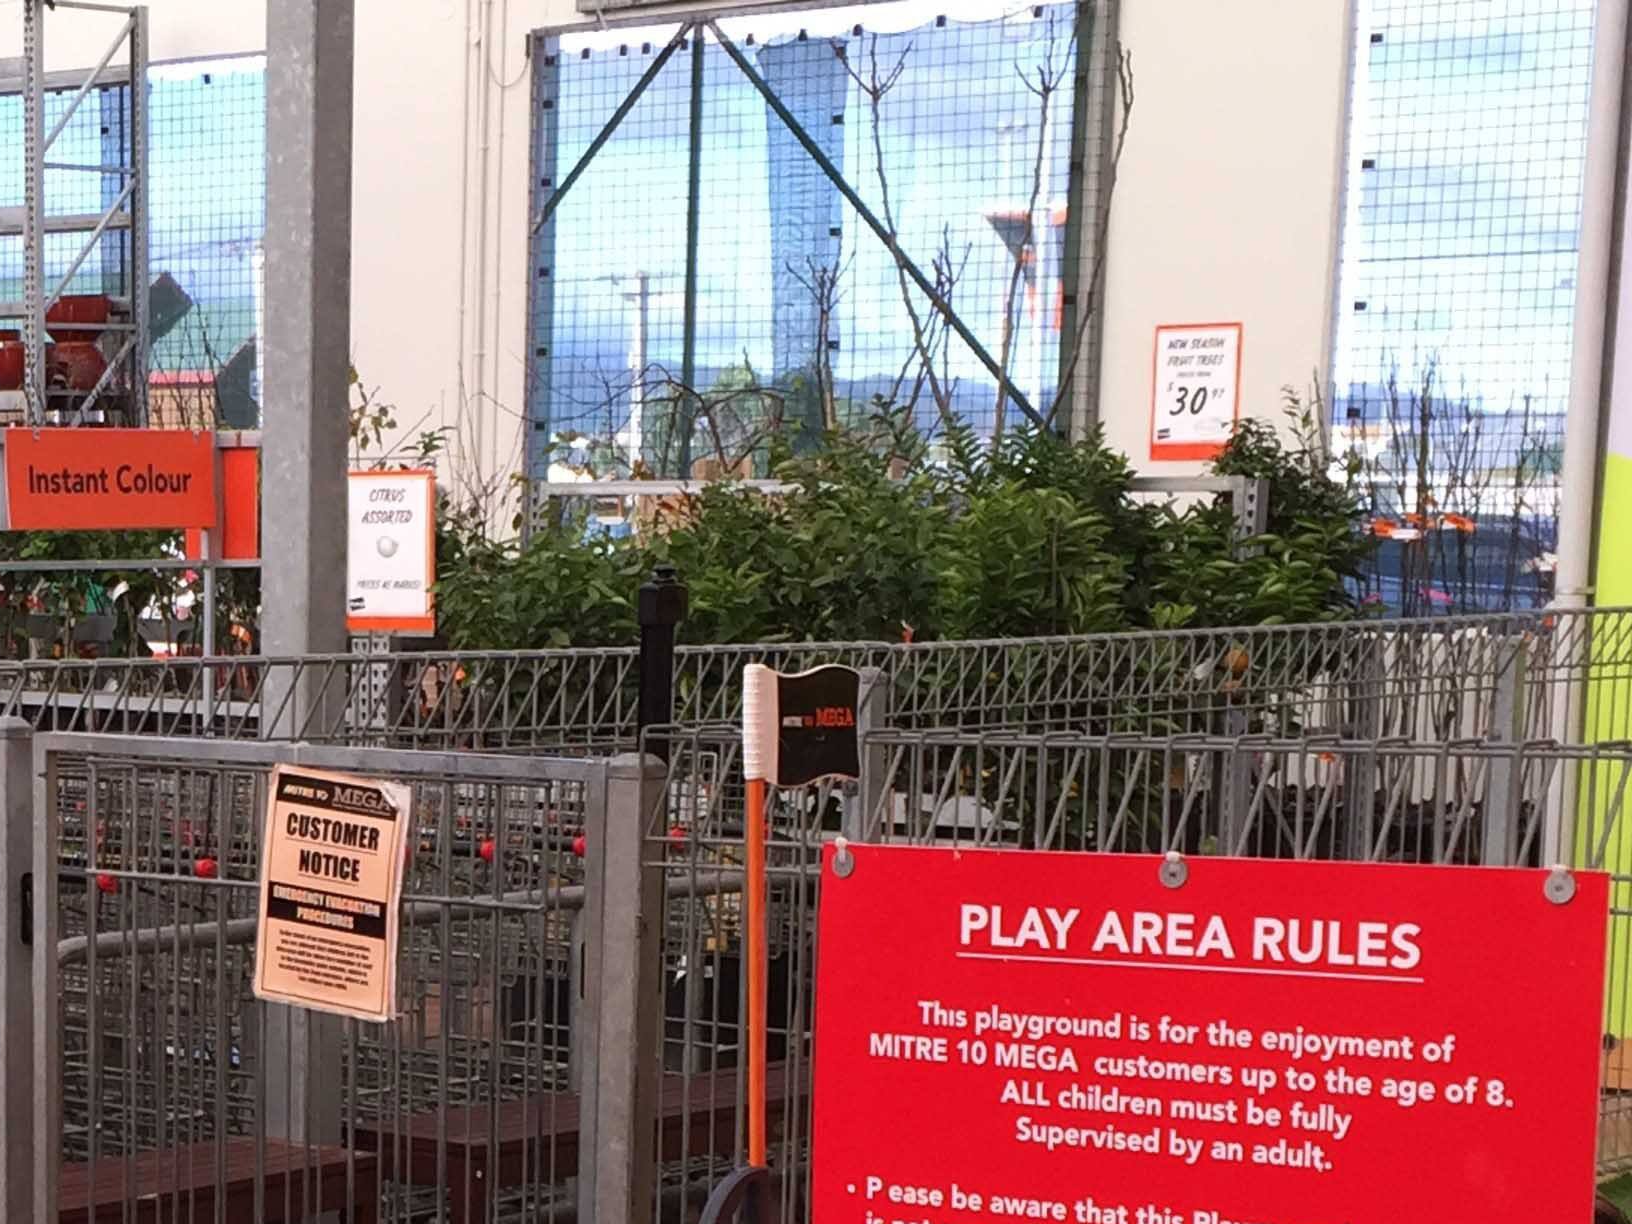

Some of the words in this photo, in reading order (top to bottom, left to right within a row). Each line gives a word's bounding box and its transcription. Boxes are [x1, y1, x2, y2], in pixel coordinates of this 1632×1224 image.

[1168, 339, 1189, 349] NEW
[1191, 337, 1225, 349] SEASON
[1168, 355, 1194, 366] FRUIT
[1196, 354, 1224, 366] TREES
[1169, 386, 1208, 416] 30
[29, 465, 109, 494] Instant
[117, 464, 191, 494] Colour
[369, 488, 406, 503] CITRUS
[361, 510, 413, 524] ASSORTED
[287, 812, 380, 850] CUSTOMER
[299, 849, 361, 882] NOTICE
[961, 904, 1079, 950] PLAY
[1092, 911, 1234, 960] AREA
[1253, 918, 1421, 970] RULES
[918, 1001, 967, 1028] This
[976, 1004, 1120, 1041] playground
[1129, 1015, 1151, 1041] is
[1158, 1016, 1200, 1044] for
[1206, 1020, 1253, 1048] the
[1262, 1027, 1413, 1063] enjoyment
[1423, 1034, 1456, 1063] of
[870, 1033, 947, 1062] MITRE
[958, 1040, 986, 1065] 10
[996, 1043, 1079, 1073] MEGA
[1094, 1056, 1232, 1086] customers
[1241, 1068, 1276, 1095] up
[1285, 1066, 1315, 1092] to
[1324, 1067, 1372, 1096] the
[1381, 1079, 1436, 1107] age
[1444, 1077, 1479, 1104] of
[1486, 1079, 1514, 1107] 8.
[1001, 1080, 1050, 1107] ALL
[1059, 1084, 1162, 1117] children
[1171, 1099, 1237, 1124] must
[1247, 1097, 1282, 1127] be
[1290, 1102, 1352, 1140] fully
[1016, 1117, 1161, 1154] Supervised
[1169, 1130, 1204, 1165] by
[1211, 1141, 1243, 1161] an
[1252, 1140, 1332, 1172] adult.
[867, 1176, 943, 1207] Pease
[952, 1184, 983, 1211] be
[990, 1196, 1067, 1221] aware
